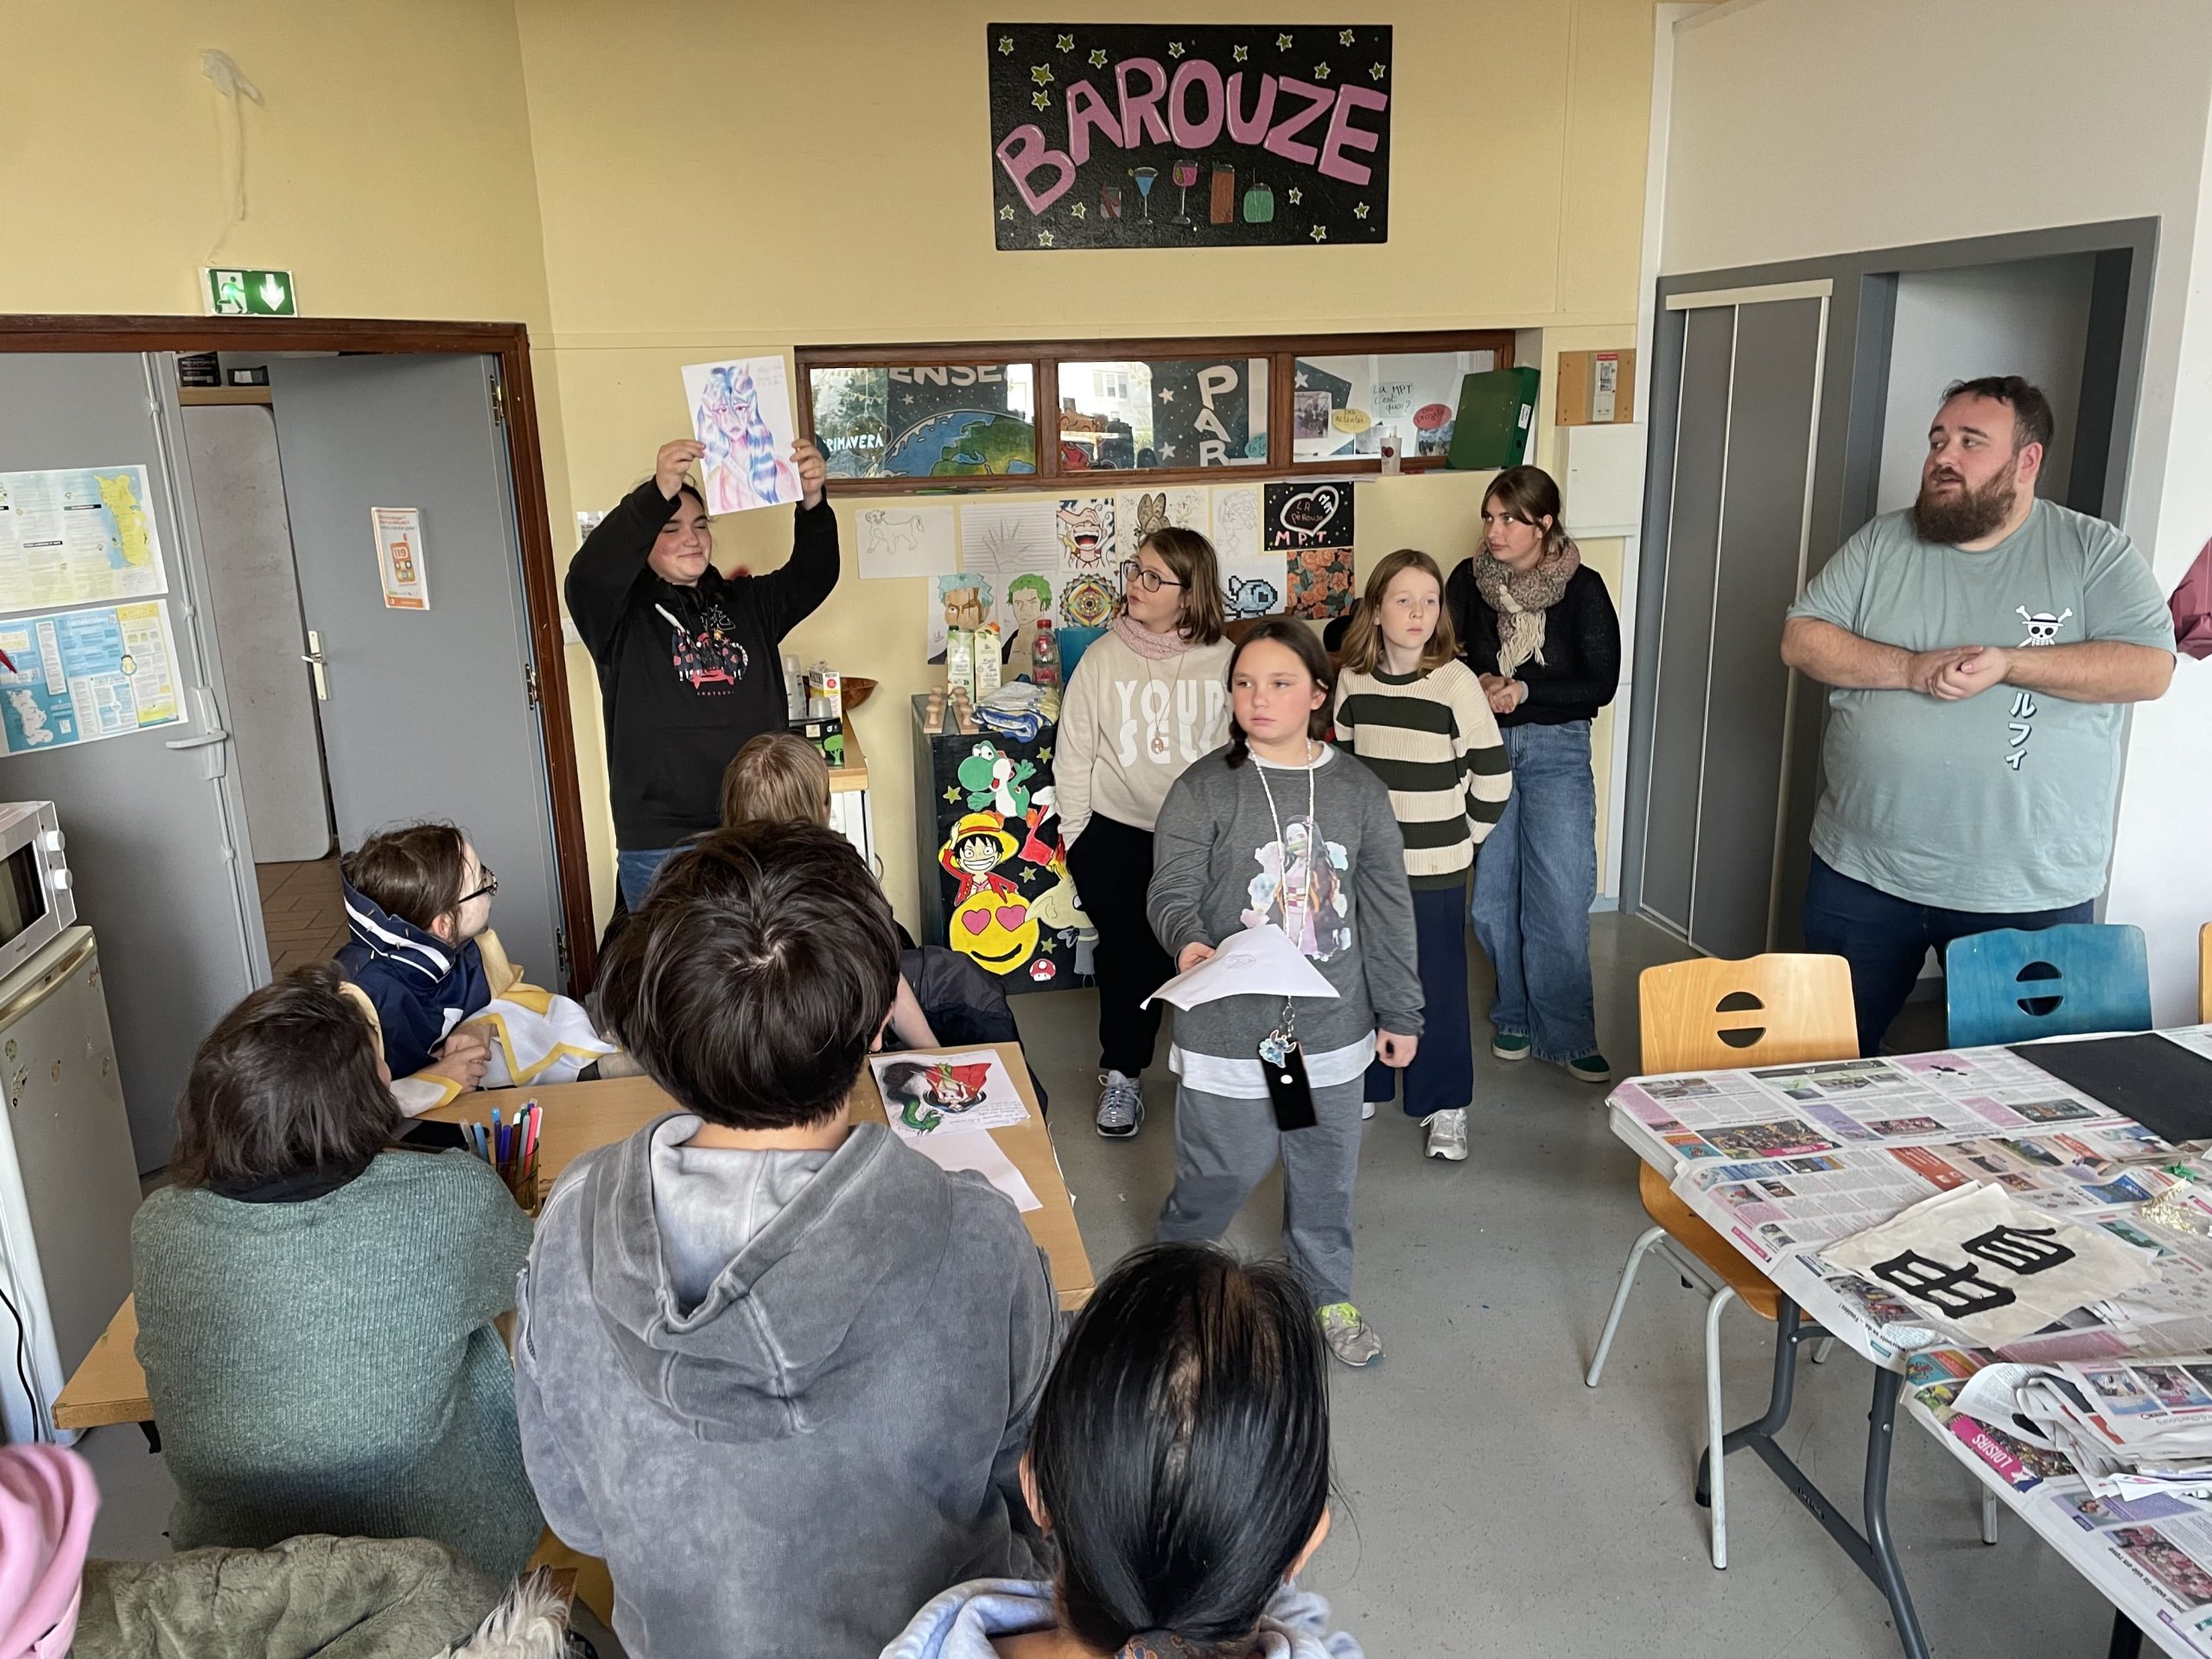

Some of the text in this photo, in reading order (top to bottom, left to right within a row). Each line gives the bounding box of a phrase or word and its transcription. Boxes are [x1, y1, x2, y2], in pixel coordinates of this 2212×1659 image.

[995, 57, 1389, 215] BAROUZE
[1392, 385, 1412, 395] MPT
[823, 432, 885, 452] RIMAVERA
[1296, 500, 1311, 512] LA
[2005, 691, 2037, 771] ルフィ
[1971, 1433, 2012, 1469] LOISIRS
